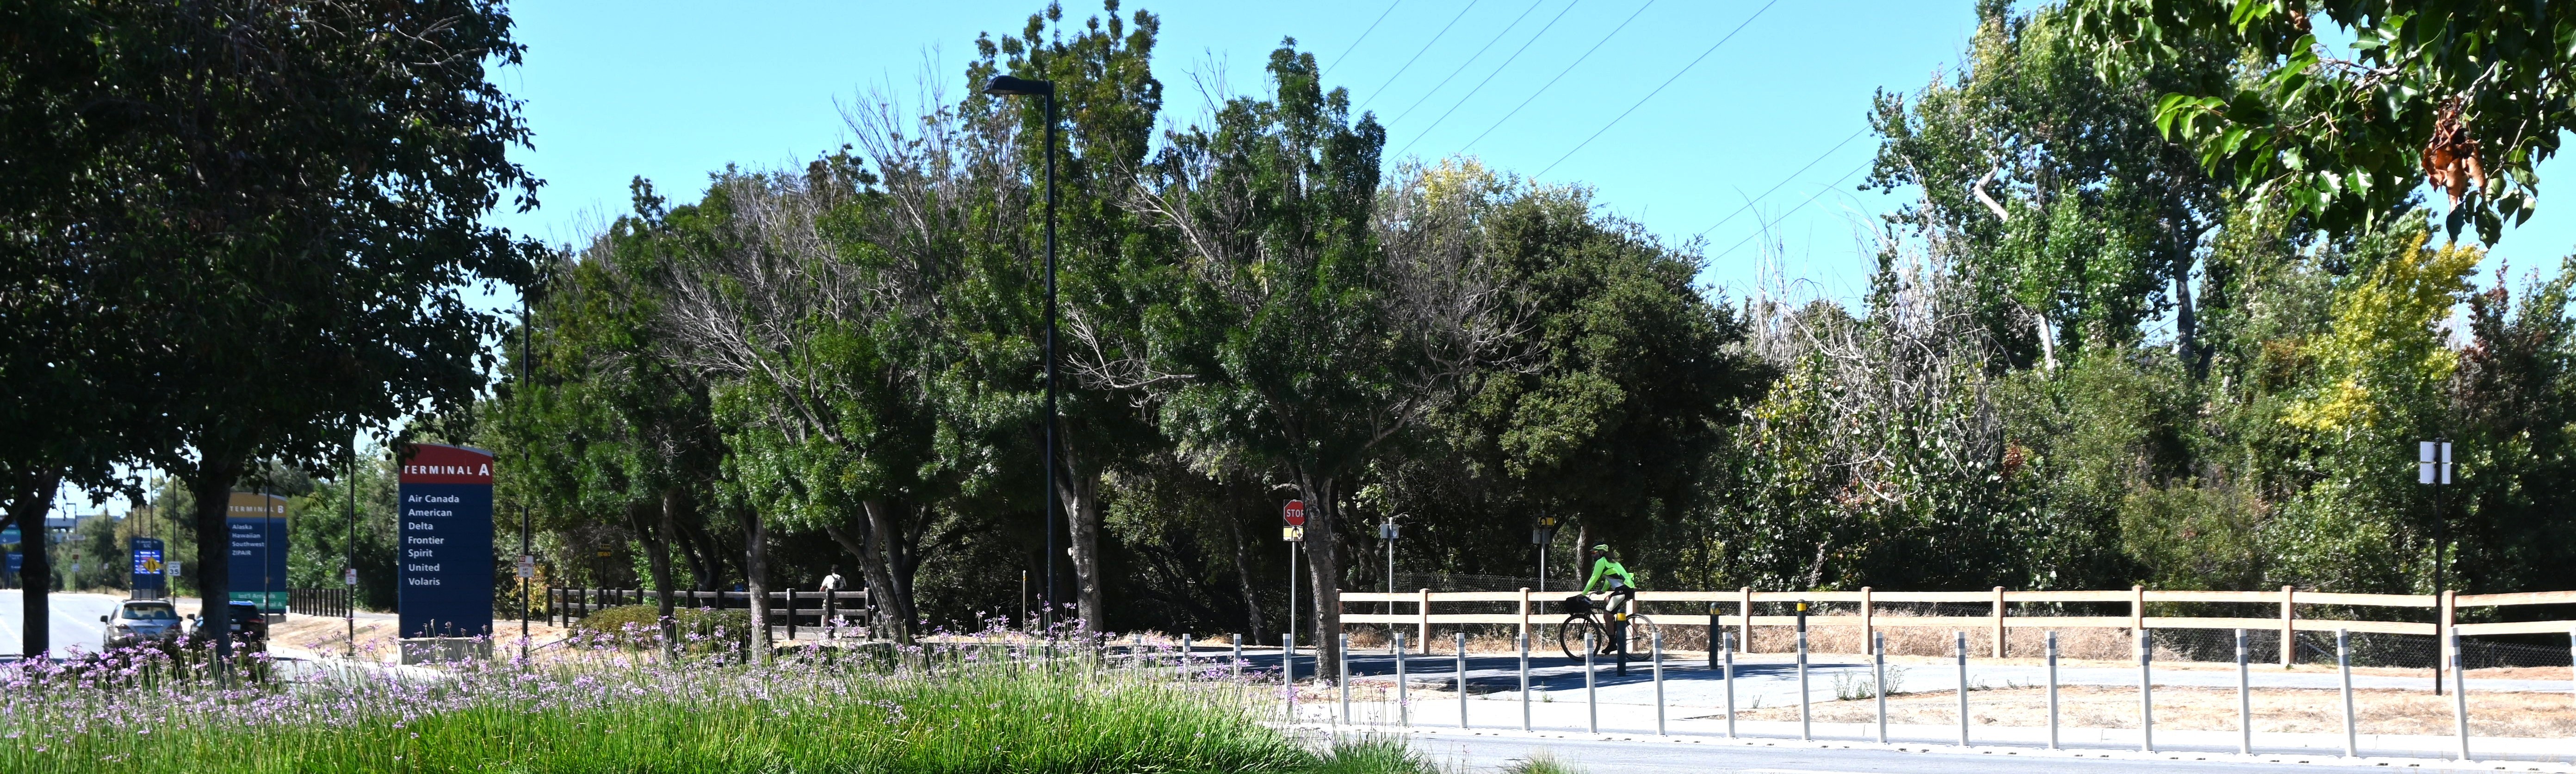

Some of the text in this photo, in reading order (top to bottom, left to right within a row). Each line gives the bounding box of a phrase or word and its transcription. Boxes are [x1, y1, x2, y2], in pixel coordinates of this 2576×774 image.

[404, 463, 489, 476] TERMINAL A
[408, 494, 459, 503] Air Canada
[278, 505, 284, 513] B
[408, 508, 452, 517] American
[1286, 509, 1304, 518] STOP
[408, 522, 433, 530] Delta
[408, 536, 444, 544] Frontier
[408, 549, 433, 559] Spirit
[408, 577, 440, 586] Volaris
